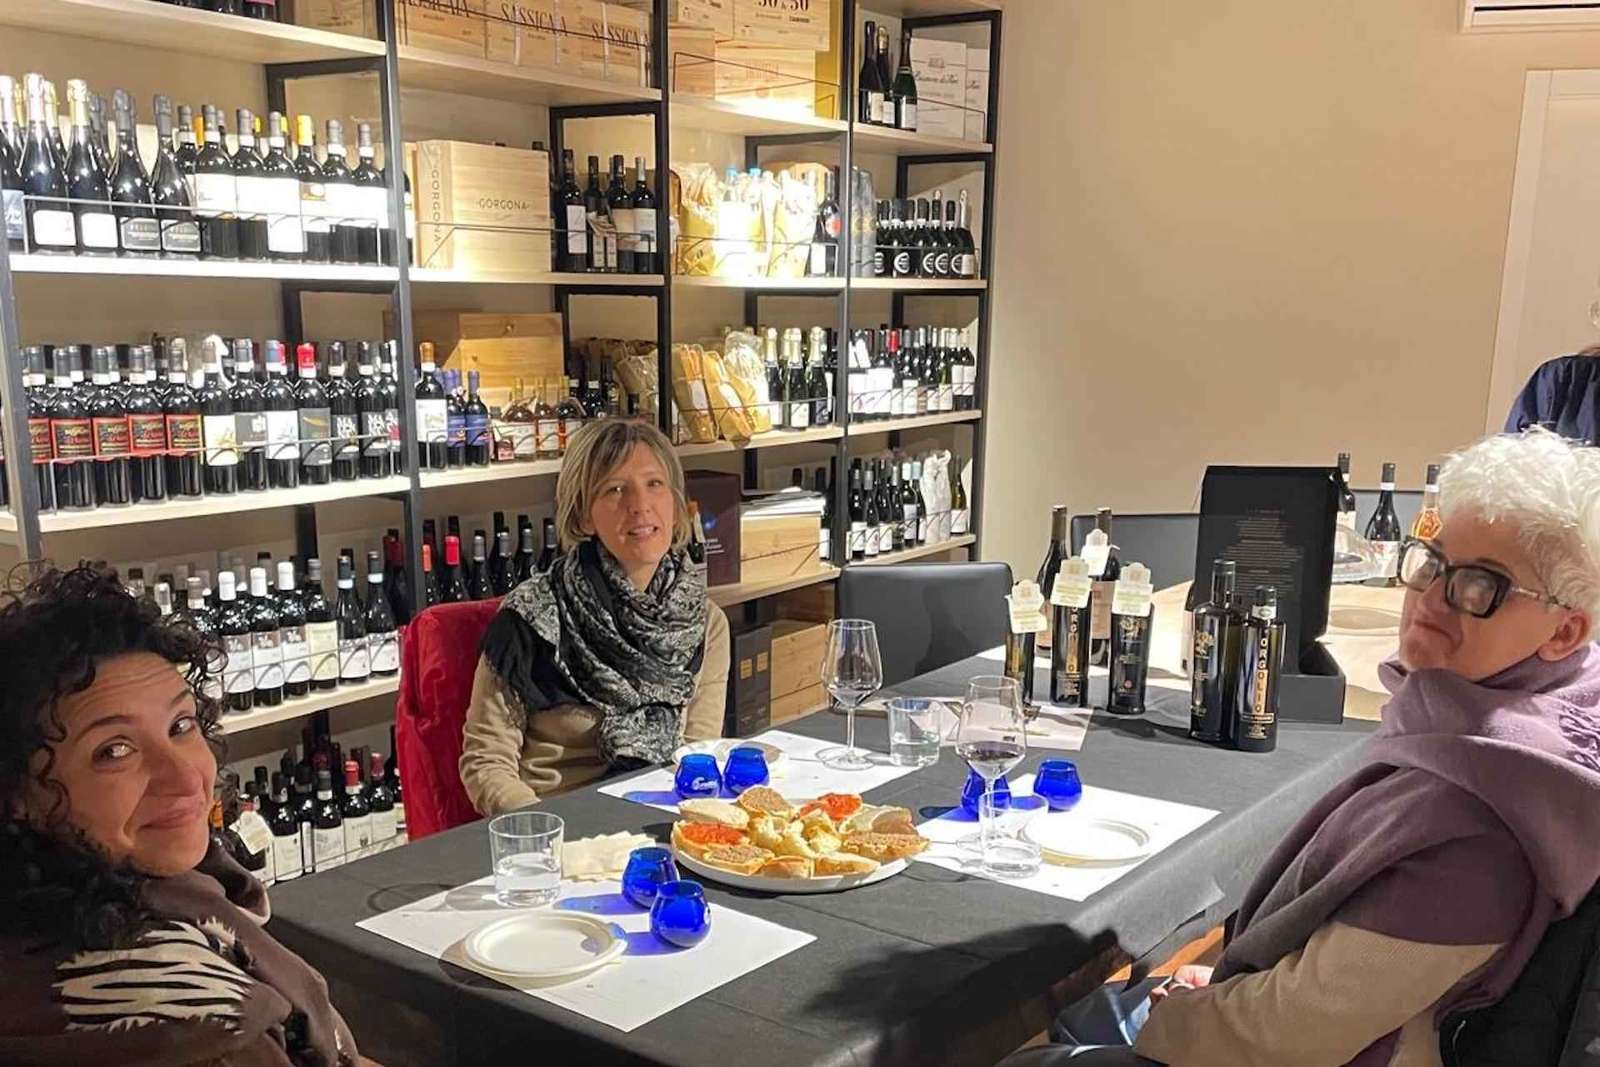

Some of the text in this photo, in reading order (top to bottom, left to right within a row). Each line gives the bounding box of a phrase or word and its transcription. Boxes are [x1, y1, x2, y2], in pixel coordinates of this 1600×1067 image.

[501, 3, 568, 36] SASSICAA
[592, 22, 649, 50] SASSICAA
[431, 169, 441, 242] GORGONA
[478, 198, 529, 211] GORGONA
[1253, 637, 1269, 713] ORGOLIO
